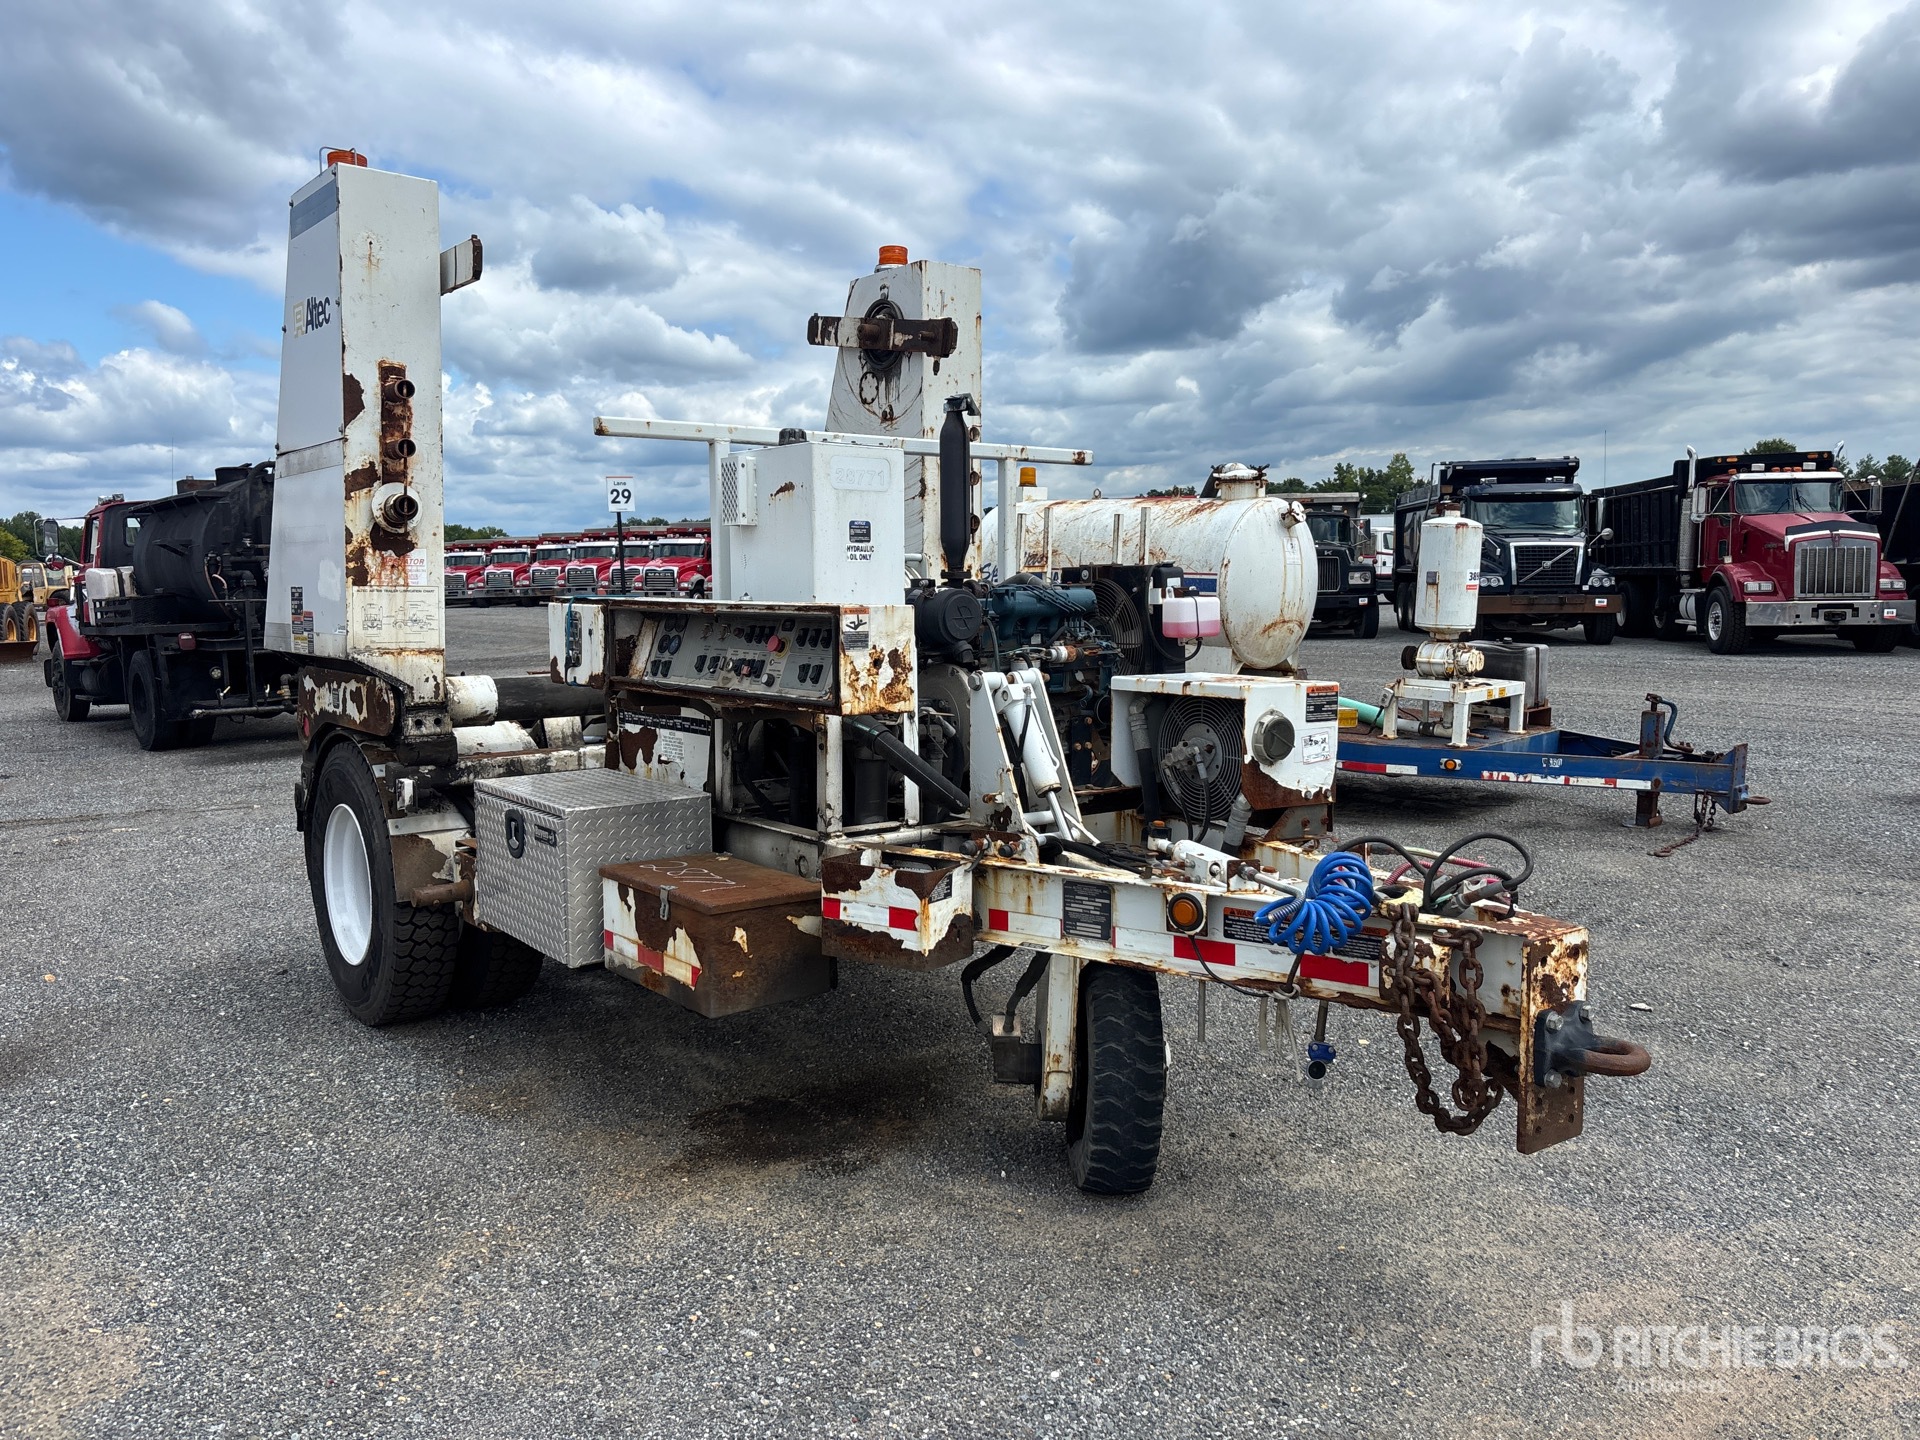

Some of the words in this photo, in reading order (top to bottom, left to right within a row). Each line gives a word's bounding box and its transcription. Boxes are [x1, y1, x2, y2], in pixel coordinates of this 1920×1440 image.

[305, 296, 331, 334] Altec
[835, 467, 885, 486] 28771
[610, 488, 632, 504] 29
[846, 545, 875, 553] HYDRAULIC
[849, 553, 858, 561] OIL
[859, 553, 872, 561] ONLY
